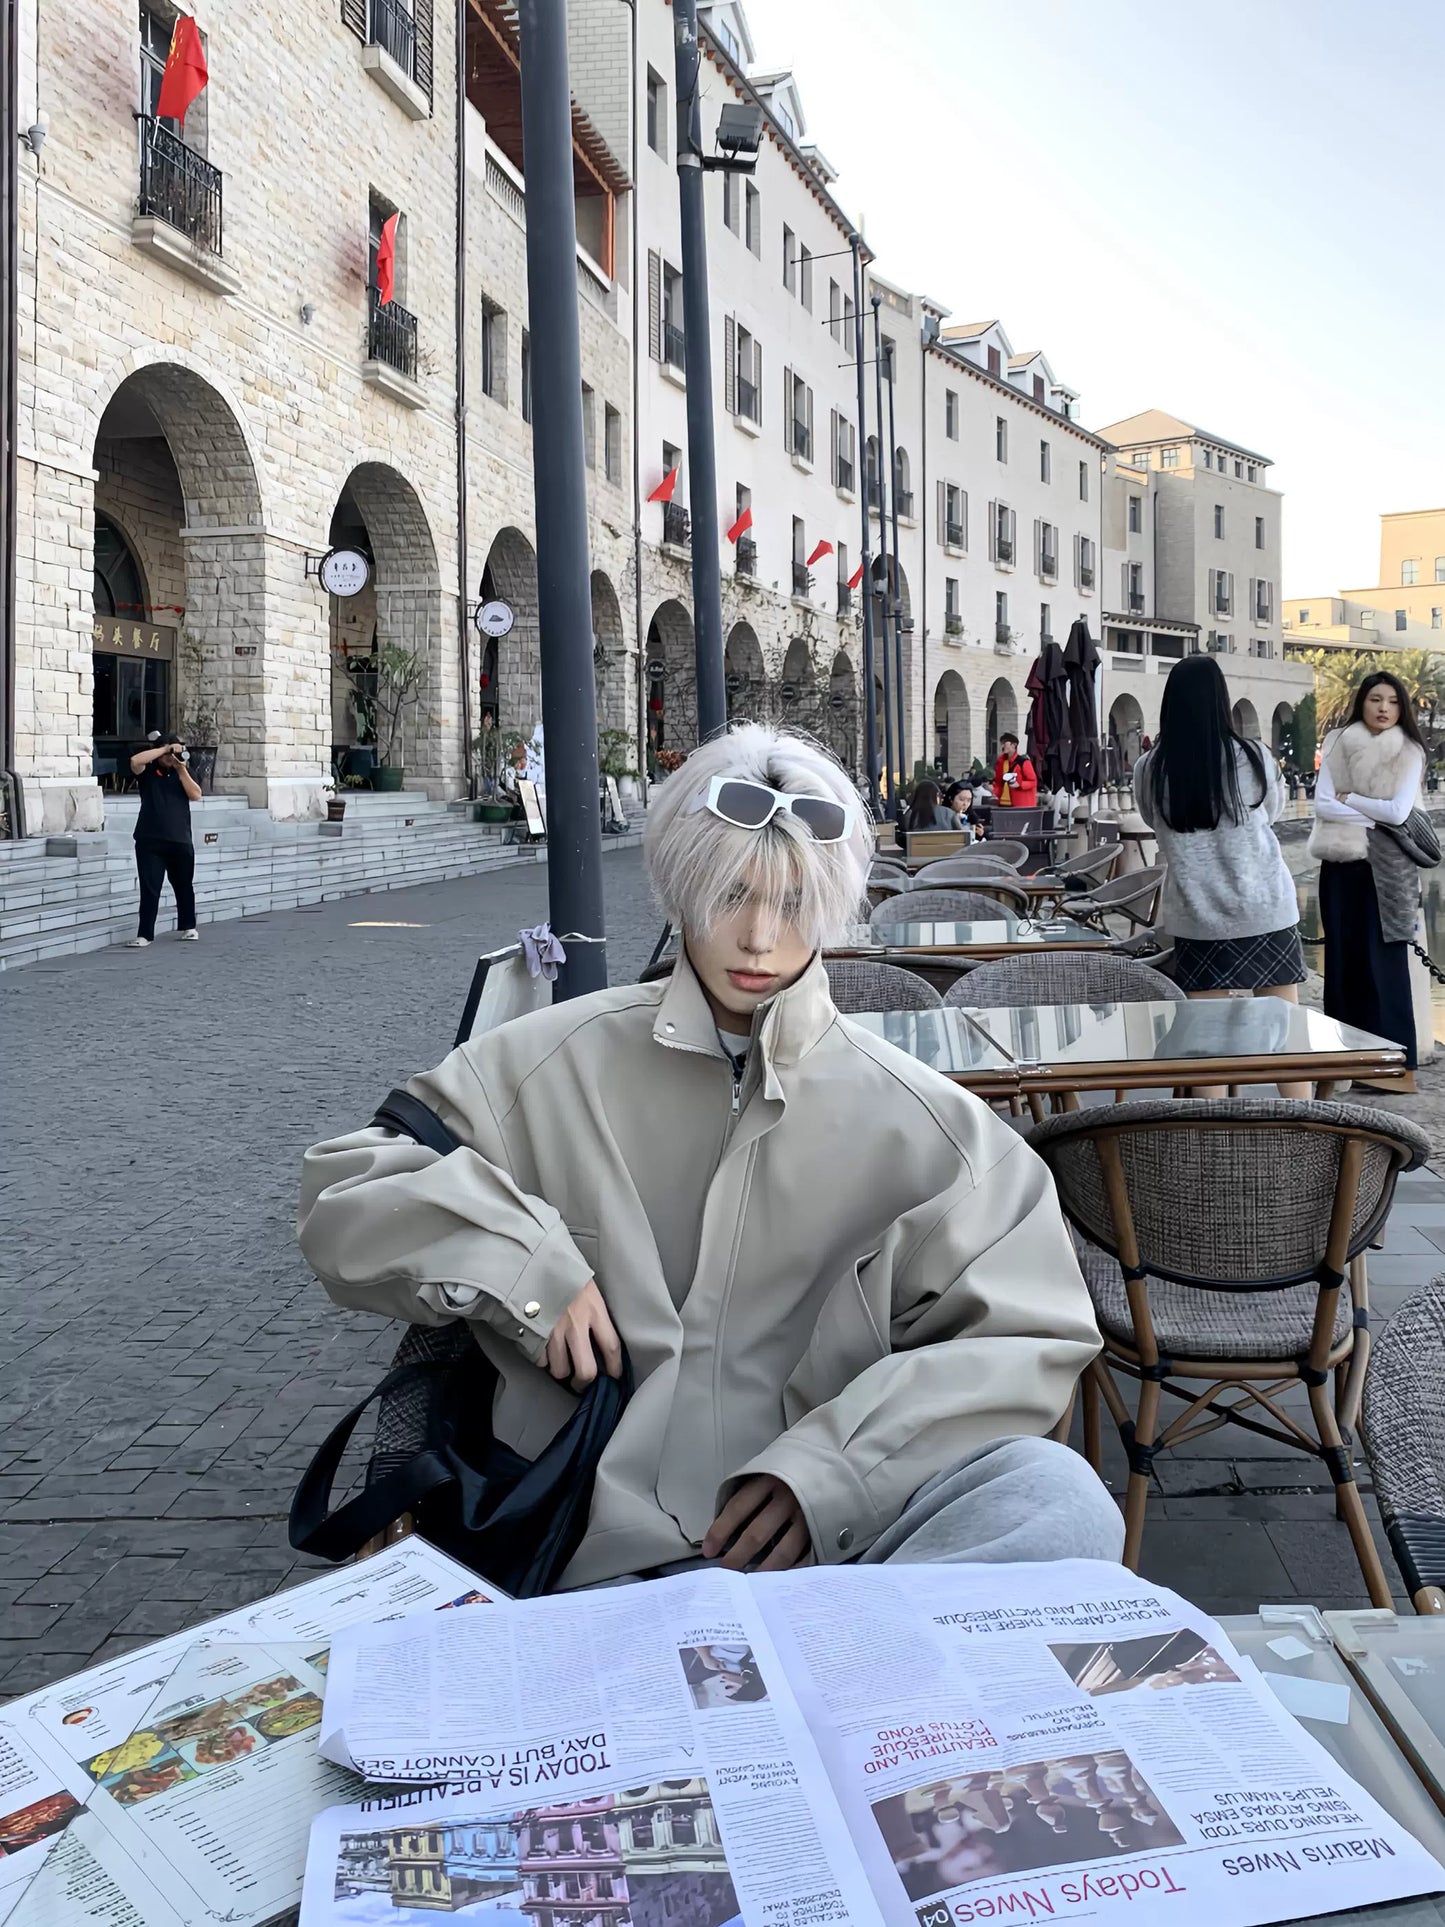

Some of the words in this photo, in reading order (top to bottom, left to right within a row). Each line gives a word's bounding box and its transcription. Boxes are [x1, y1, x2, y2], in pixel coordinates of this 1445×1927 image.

[1044, 1606, 1074, 1618] AND
[1076, 1597, 1160, 1616] BEAUTIFUL
[932, 1606, 1041, 1625] PICTURESQUE
[1118, 1610, 1153, 1622] OUR
[961, 1624, 974, 1634] A
[975, 1623, 992, 1633] IS
[993, 1618, 1044, 1631] THERE
[876, 1724, 925, 1741] POND
[928, 1718, 984, 1733] LOTUS
[560, 1733, 606, 1754] DAY,
[870, 1727, 992, 1758] PICTURESQUE
[902, 1736, 998, 1762] BEAUTIFUL
[402, 1755, 494, 1770] CANNOT
[501, 1754, 506, 1767] I
[512, 1744, 556, 1766] BUT
[535, 1751, 611, 1784] TODAY
[863, 1754, 900, 1774] AND
[508, 1766, 529, 1787] IS
[1214, 1790, 1280, 1806] NAMLUS
[1282, 1786, 1341, 1801] VELIPS
[1190, 1808, 1238, 1824] EMSA
[1240, 1802, 1304, 1818] ATORAS
[1289, 1813, 1363, 1828] HEADING
[1302, 1838, 1396, 1866] Mauris
[1222, 1850, 1302, 1876] Nwes
[1060, 1866, 1187, 1904] Todays
[954, 1887, 1056, 1924] Nwes
